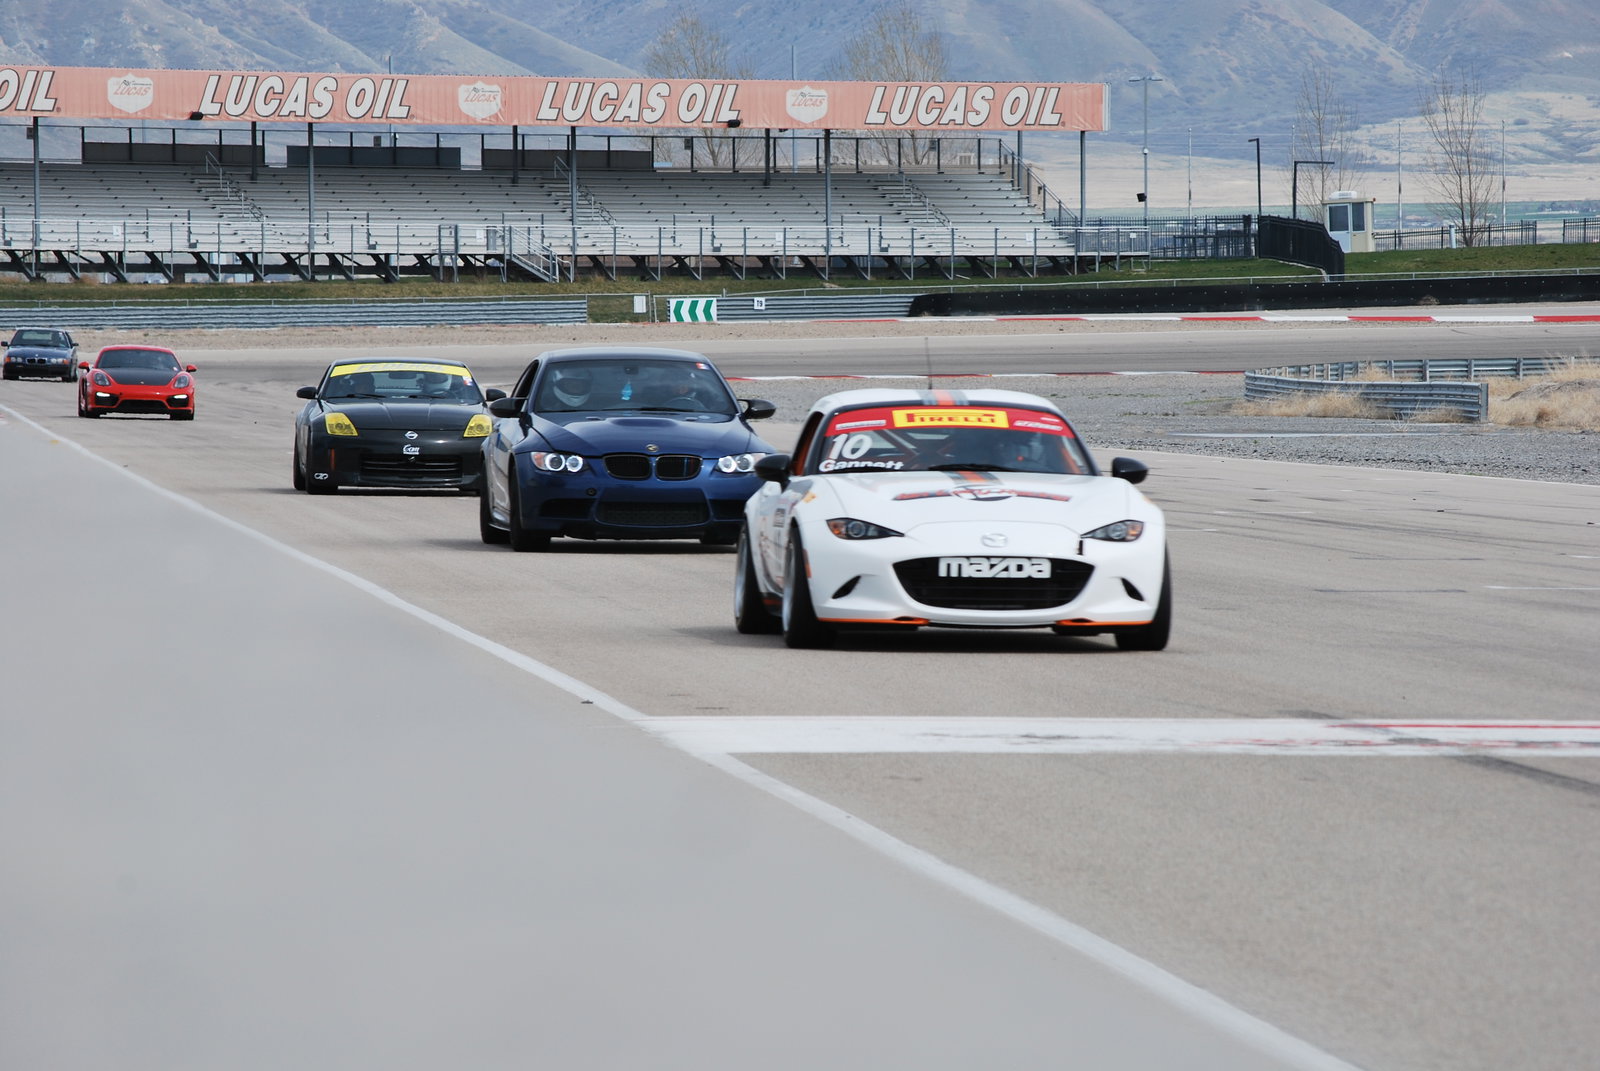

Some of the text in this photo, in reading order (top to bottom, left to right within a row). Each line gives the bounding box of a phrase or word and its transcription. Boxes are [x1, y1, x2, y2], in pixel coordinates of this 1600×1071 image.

[0, 68, 57, 112] OIL
[199, 75, 411, 119] LUCAS OIL
[536, 81, 740, 124] LUCAS OIL
[864, 85, 1062, 126] LUCAS OIL
[906, 412, 997, 424] PIRELLI
[829, 430, 872, 460] 10
